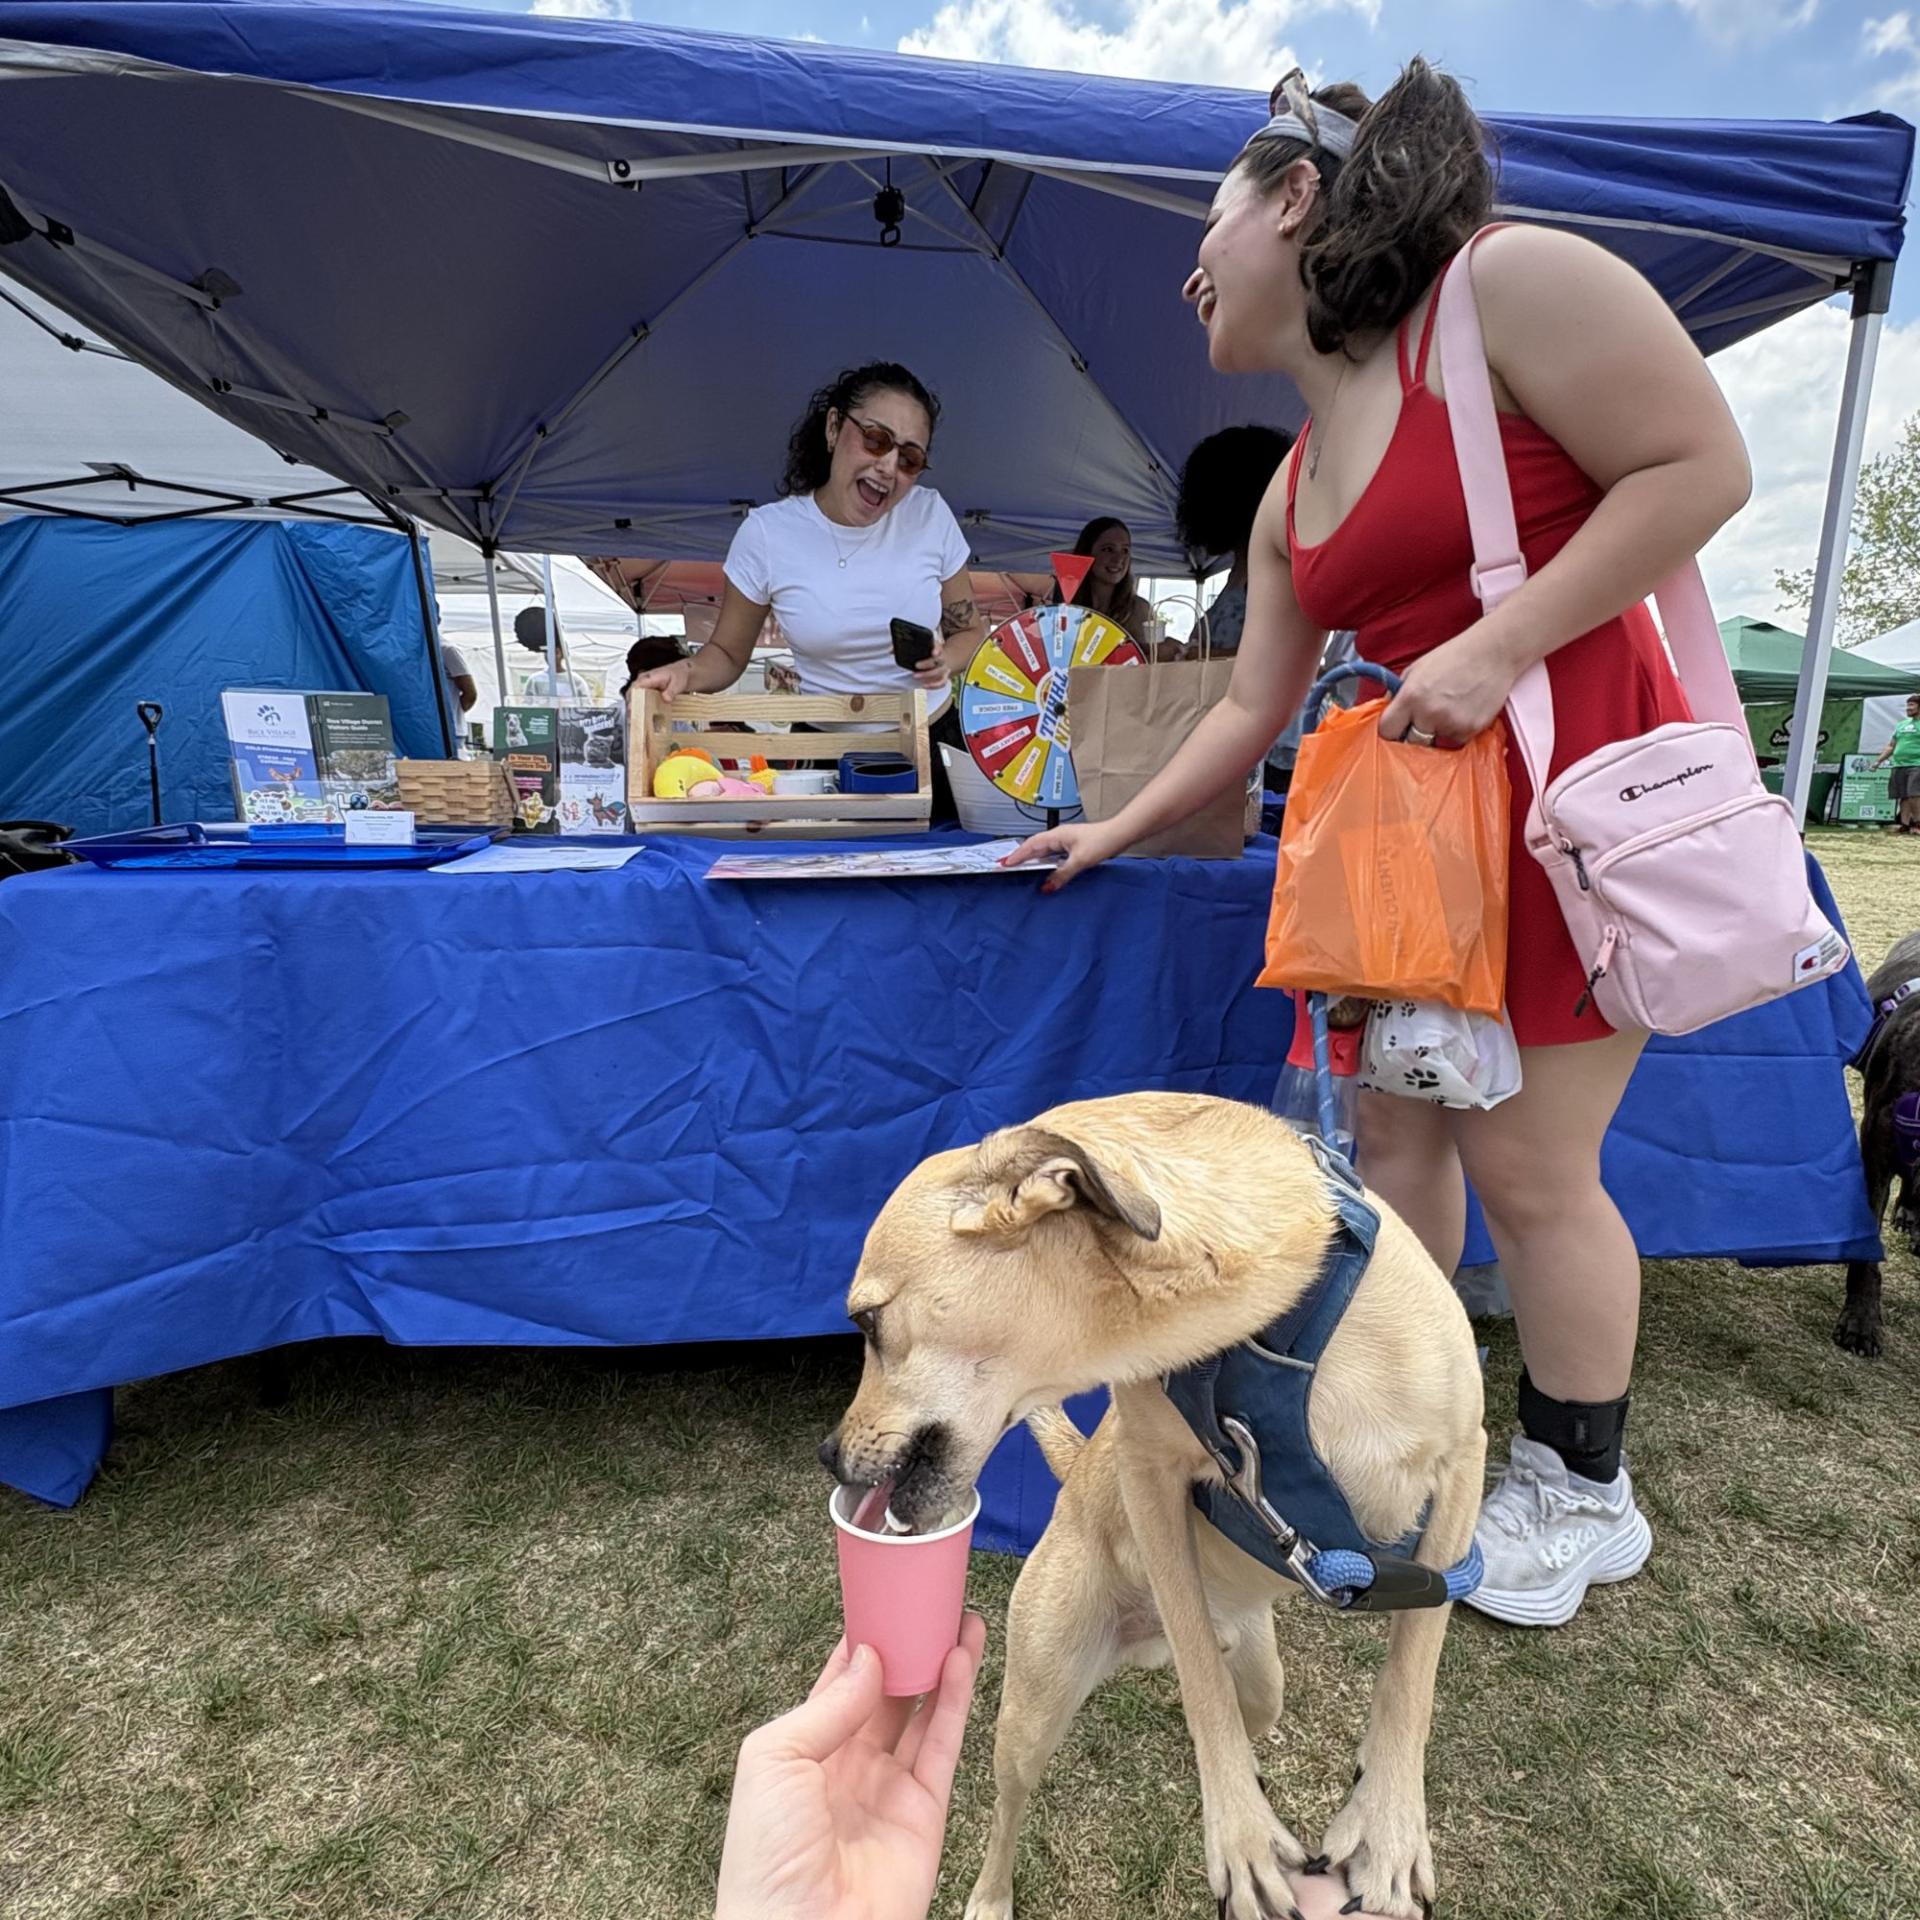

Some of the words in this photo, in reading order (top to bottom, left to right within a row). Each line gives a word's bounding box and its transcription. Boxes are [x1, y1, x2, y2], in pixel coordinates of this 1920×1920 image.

[1040, 672, 1068, 738] THRILL
[1619, 763, 1714, 802] Champion
[1539, 1525, 1598, 1571] HOKA
